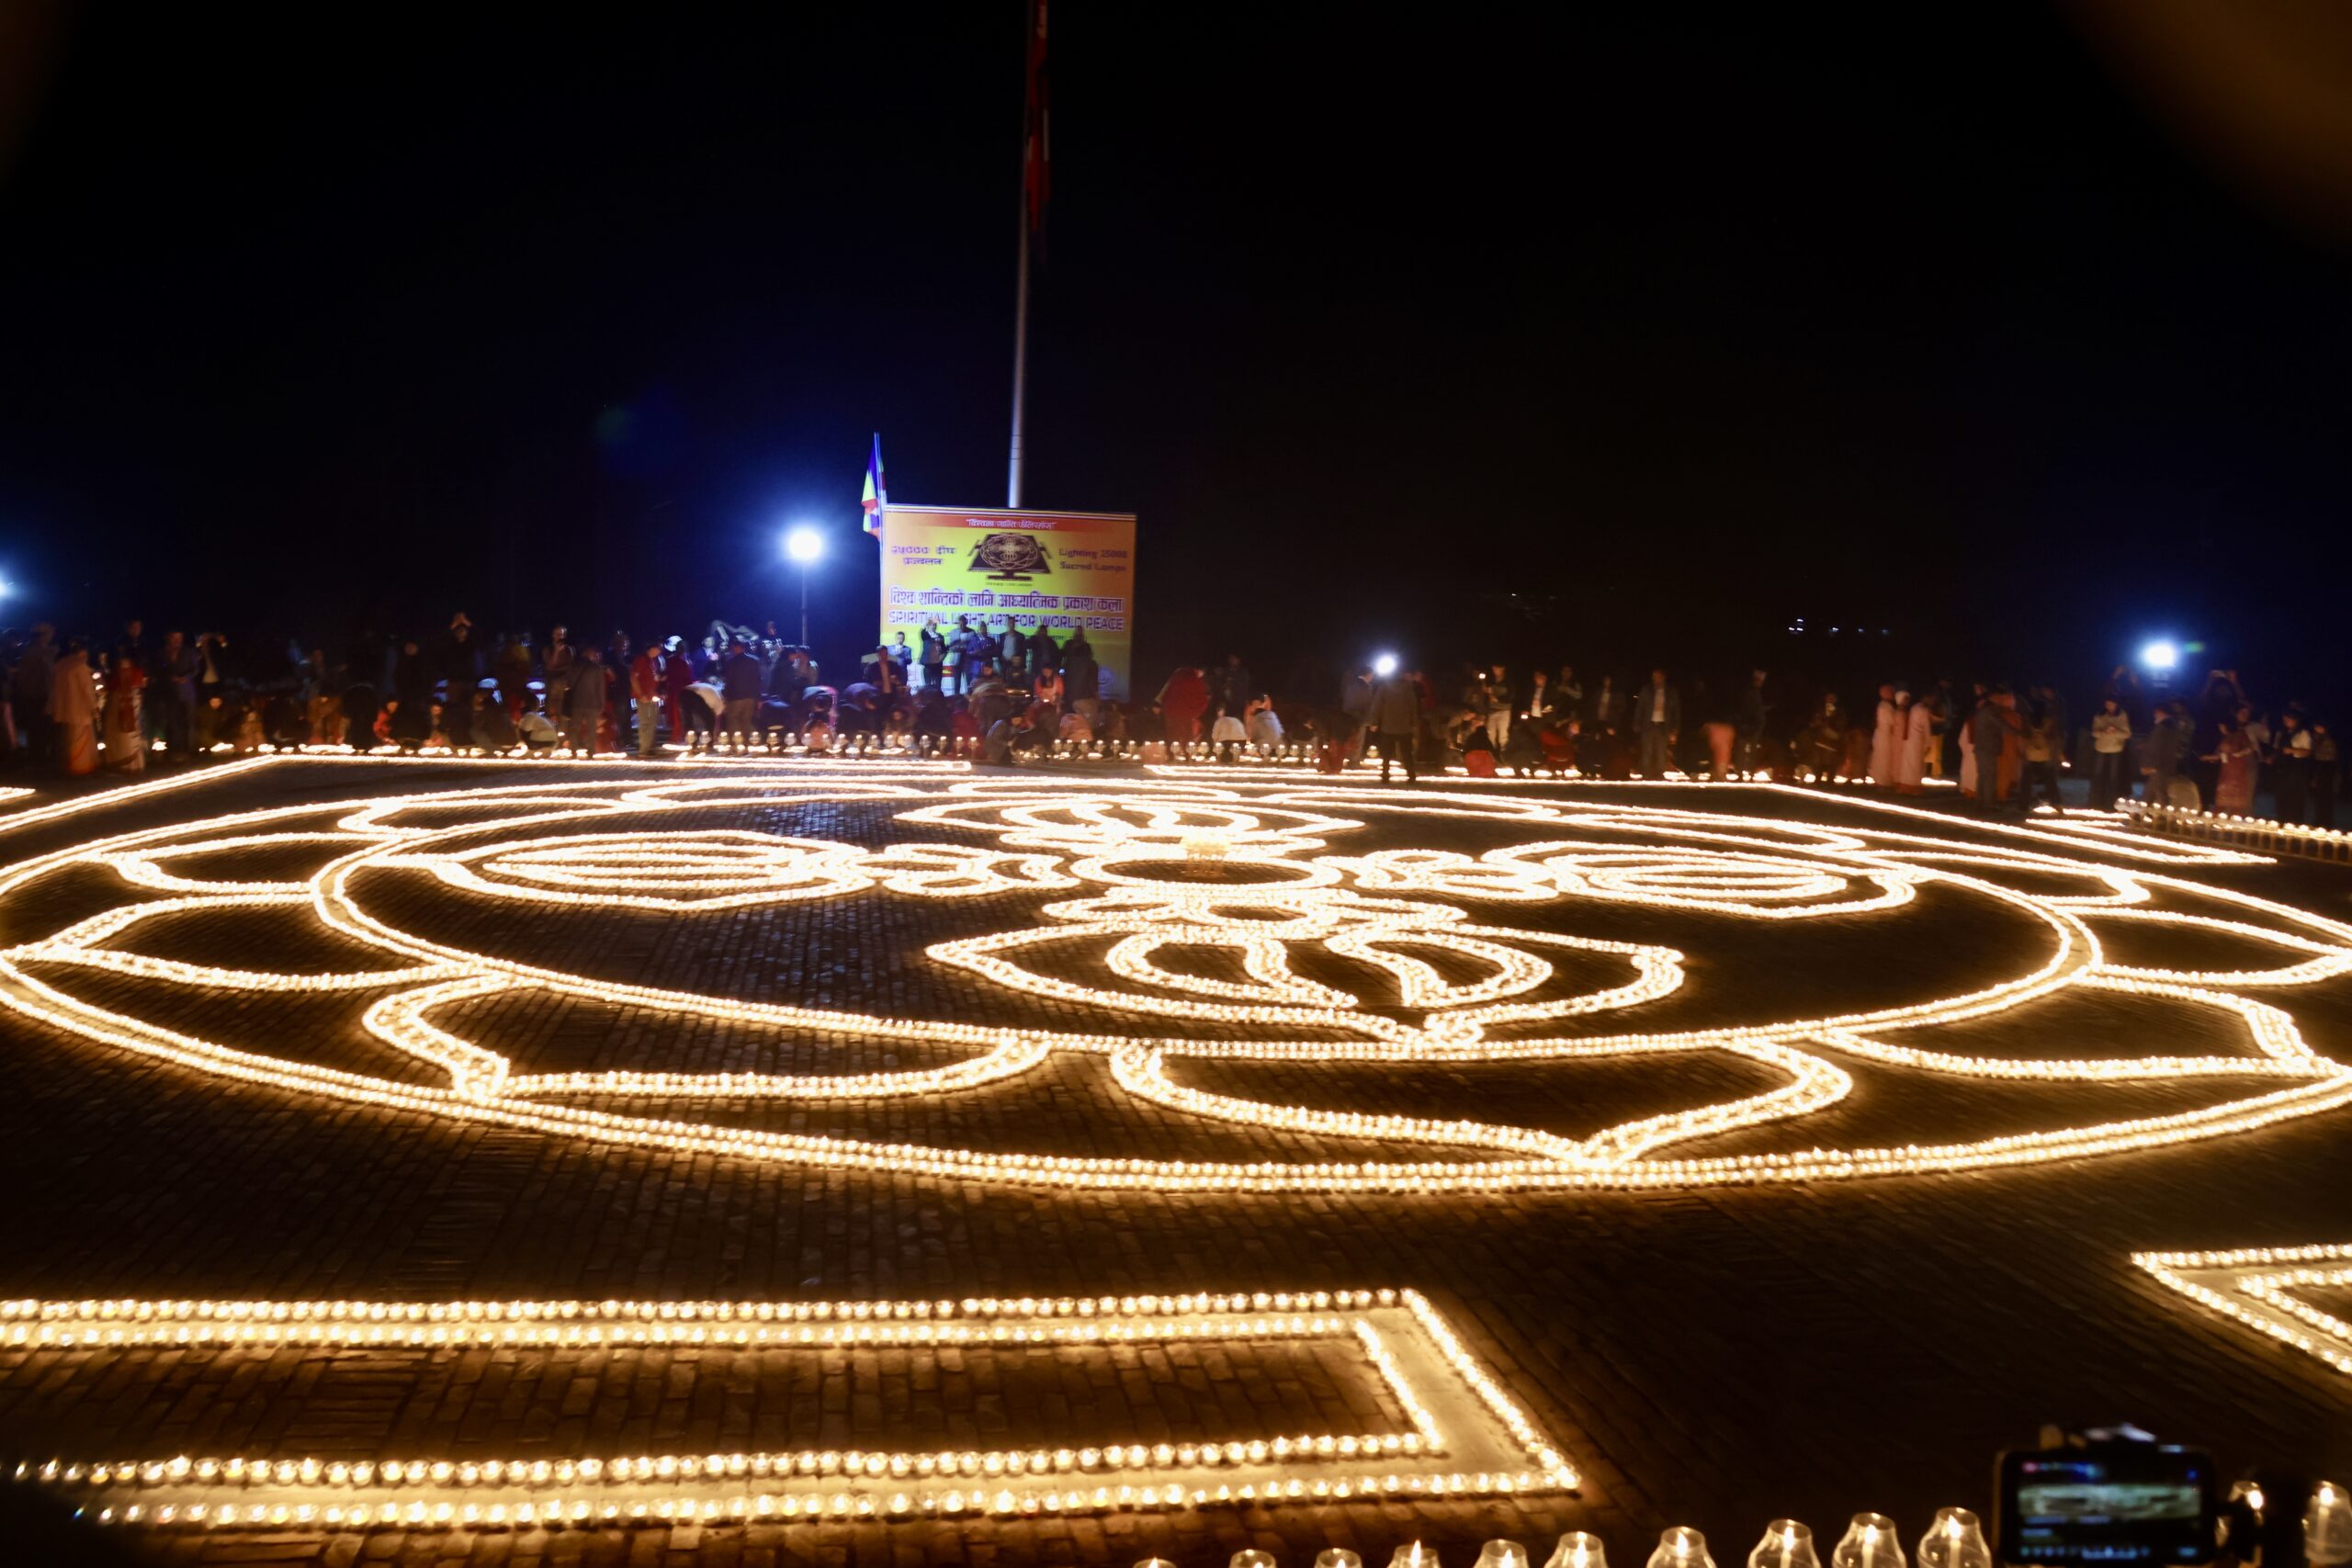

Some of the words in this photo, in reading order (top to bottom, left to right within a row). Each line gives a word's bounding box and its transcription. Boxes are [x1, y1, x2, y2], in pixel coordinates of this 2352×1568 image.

[1059, 561, 1091, 570] Sacred
[889, 587, 915, 604] विश्व
[919, 588, 964, 606] शान्तिको
[998, 591, 1058, 610] आध्यात्मिक
[1062, 595, 1093, 613] प्रकाश
[1096, 597, 1123, 613] कला
[987, 613, 1010, 626] ART
[1013, 614, 1037, 628] FOR
[1039, 615, 1083, 629] WORLD
[1085, 616, 1124, 631] PEACE
